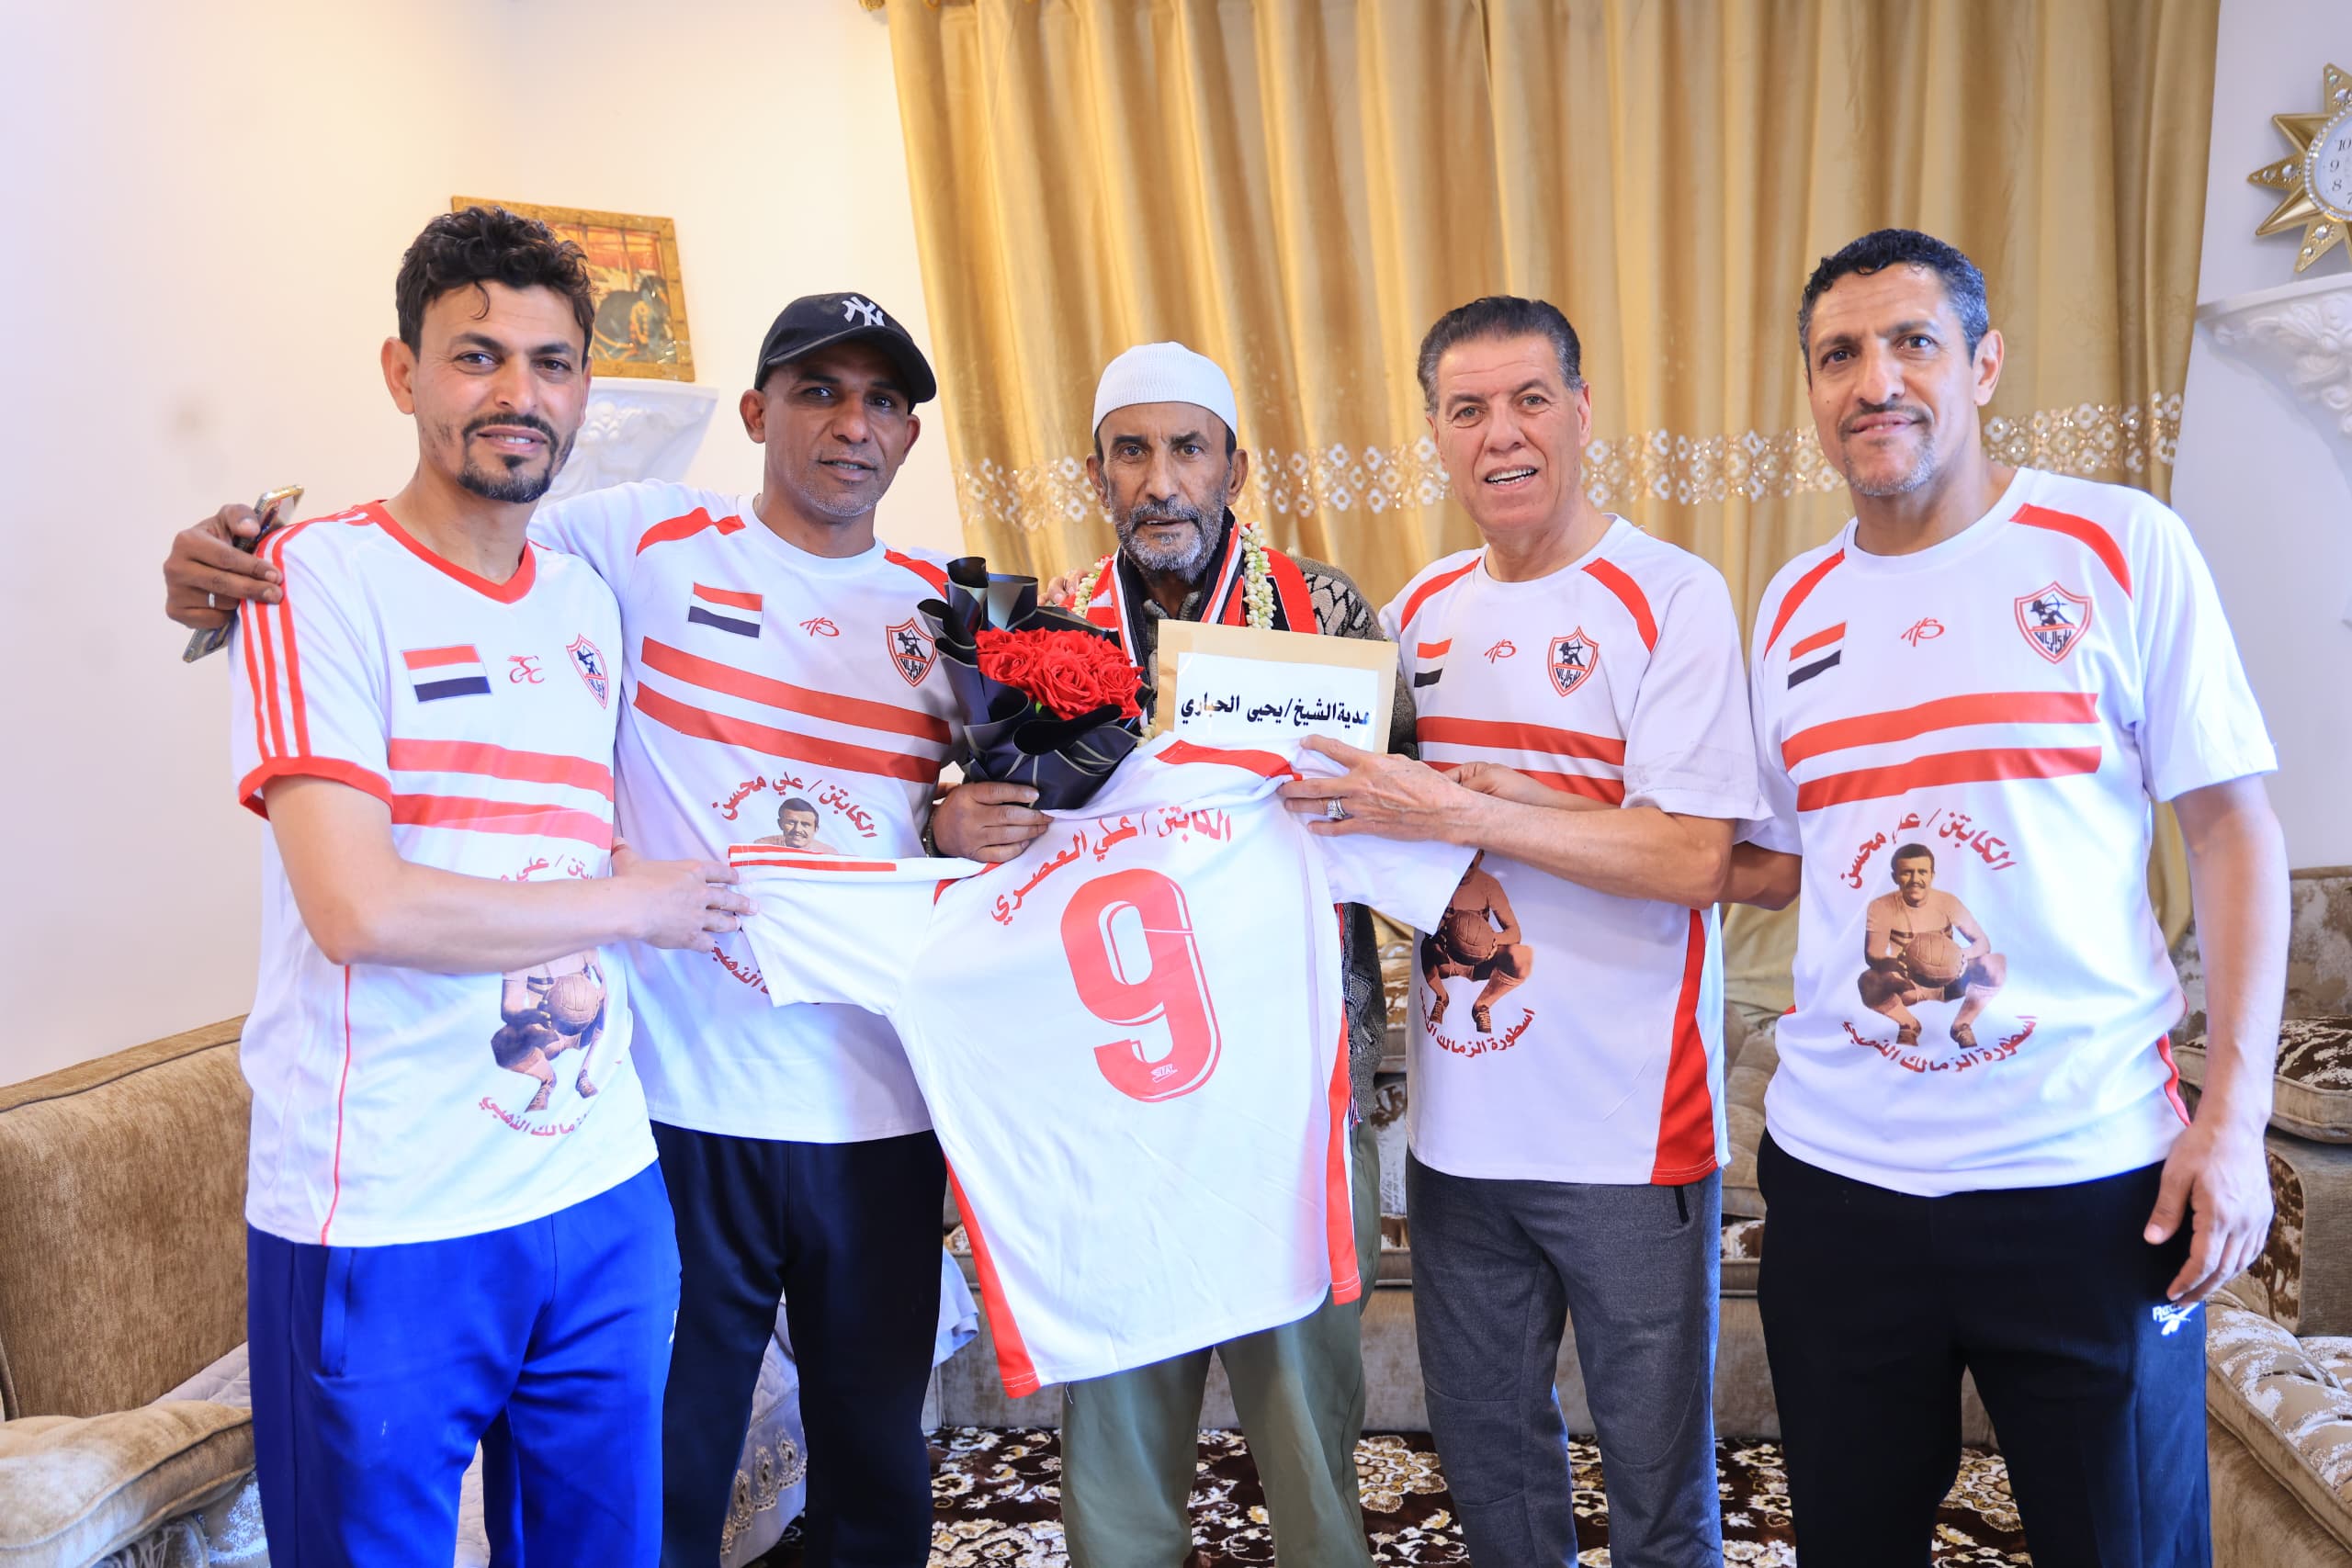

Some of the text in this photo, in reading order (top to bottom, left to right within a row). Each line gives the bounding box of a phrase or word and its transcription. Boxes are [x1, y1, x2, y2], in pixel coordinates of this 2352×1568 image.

[712, 775, 767, 820] محسن
[773, 772, 804, 795] علي
[819, 784, 877, 838] الكابتن
[1093, 816, 1138, 863] علي
[1840, 832, 1886, 889] محسن
[1939, 811, 2018, 871] الكابتن
[991, 829, 1087, 925] العصري
[712, 944, 763, 987] الذهب
[1060, 868, 1221, 1103] 9
[1436, 1035, 1487, 1058] الزمالك
[1487, 1008, 1535, 1050] اسطورة
[1900, 1052, 1979, 1073] الزمالك
[479, 1097, 531, 1132] الذهبي
